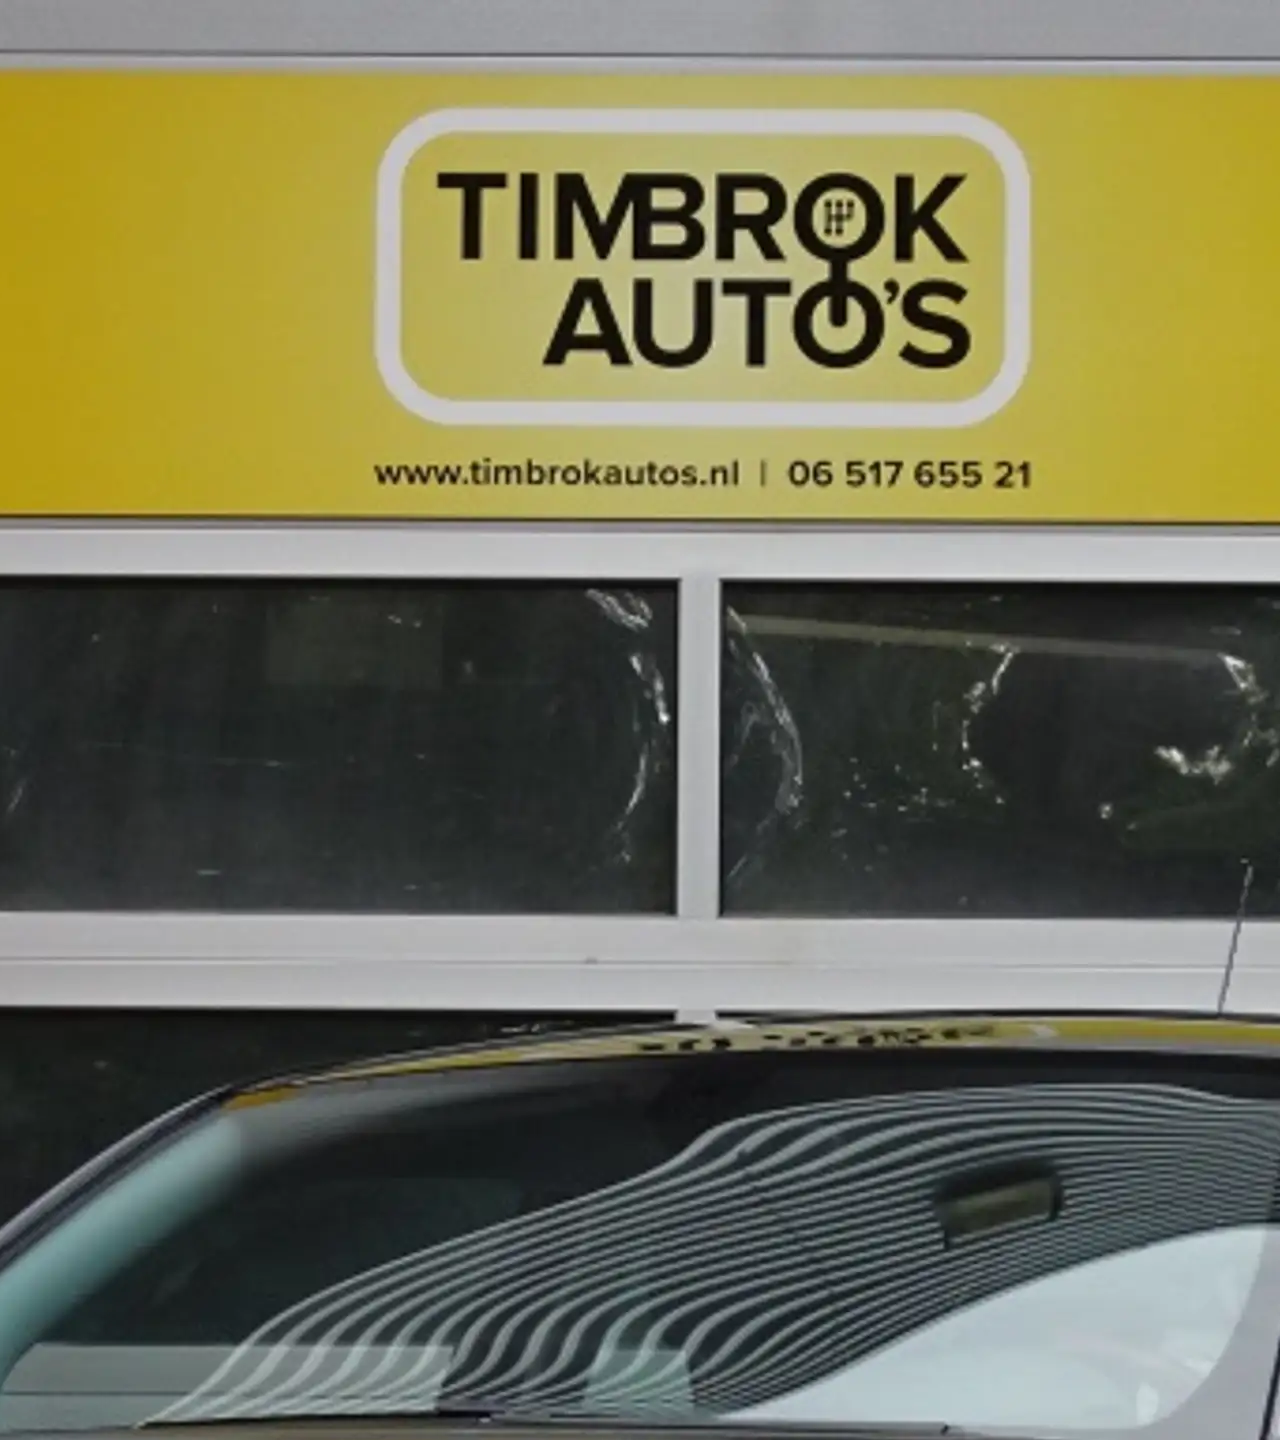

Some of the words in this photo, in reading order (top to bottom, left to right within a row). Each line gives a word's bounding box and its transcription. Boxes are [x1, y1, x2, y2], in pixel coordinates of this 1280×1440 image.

[437, 172, 969, 263] TIMBROK
[542, 277, 972, 369] AUTO'S
[373, 457, 740, 487] www.timbrokautos.nl
[787, 460, 835, 488] 06
[845, 460, 904, 488] 517
[913, 460, 983, 489] 655
[993, 460, 1032, 489] 21
